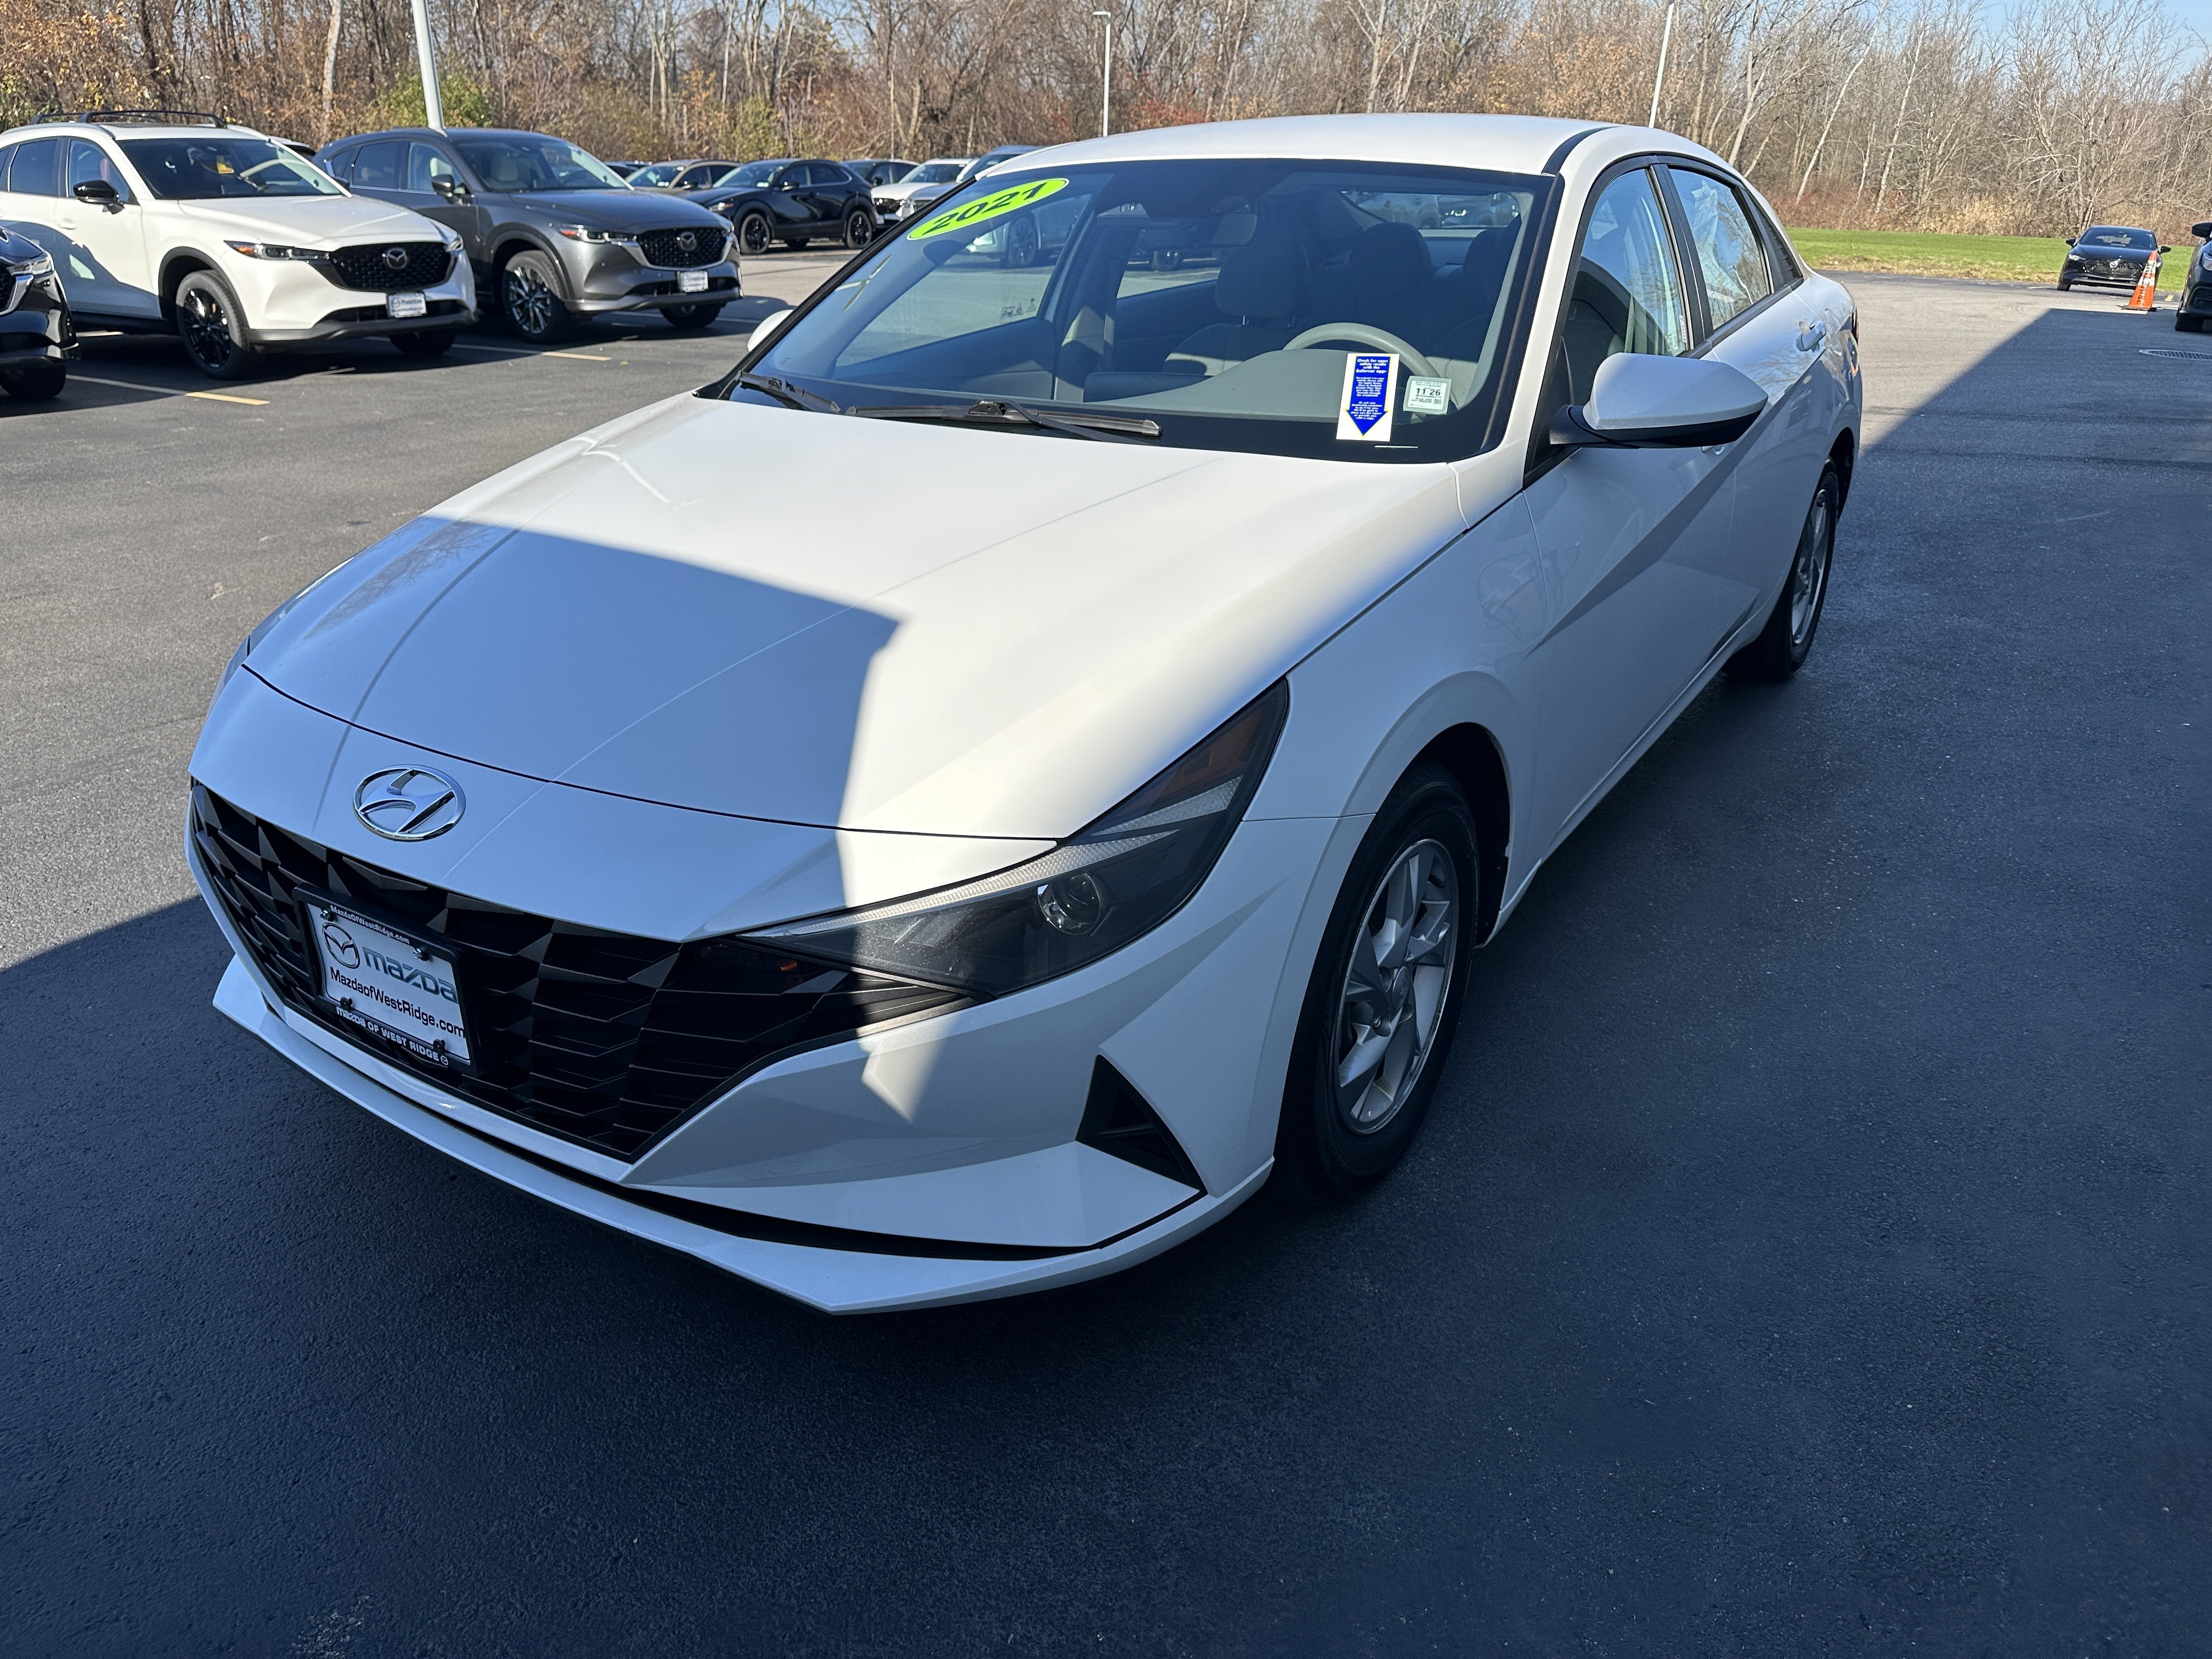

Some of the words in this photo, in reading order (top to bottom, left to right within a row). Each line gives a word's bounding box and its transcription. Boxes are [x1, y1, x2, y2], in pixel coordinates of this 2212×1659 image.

[922, 182, 1048, 236] 2021
[330, 905, 410, 945] MazdaOfWestRidge.com
[330, 966, 466, 1039] MazdaofWestRidge.com
[368, 1022, 379, 1032] OF
[381, 1026, 408, 1047] WEST
[410, 1041, 439, 1062] RIDGE
